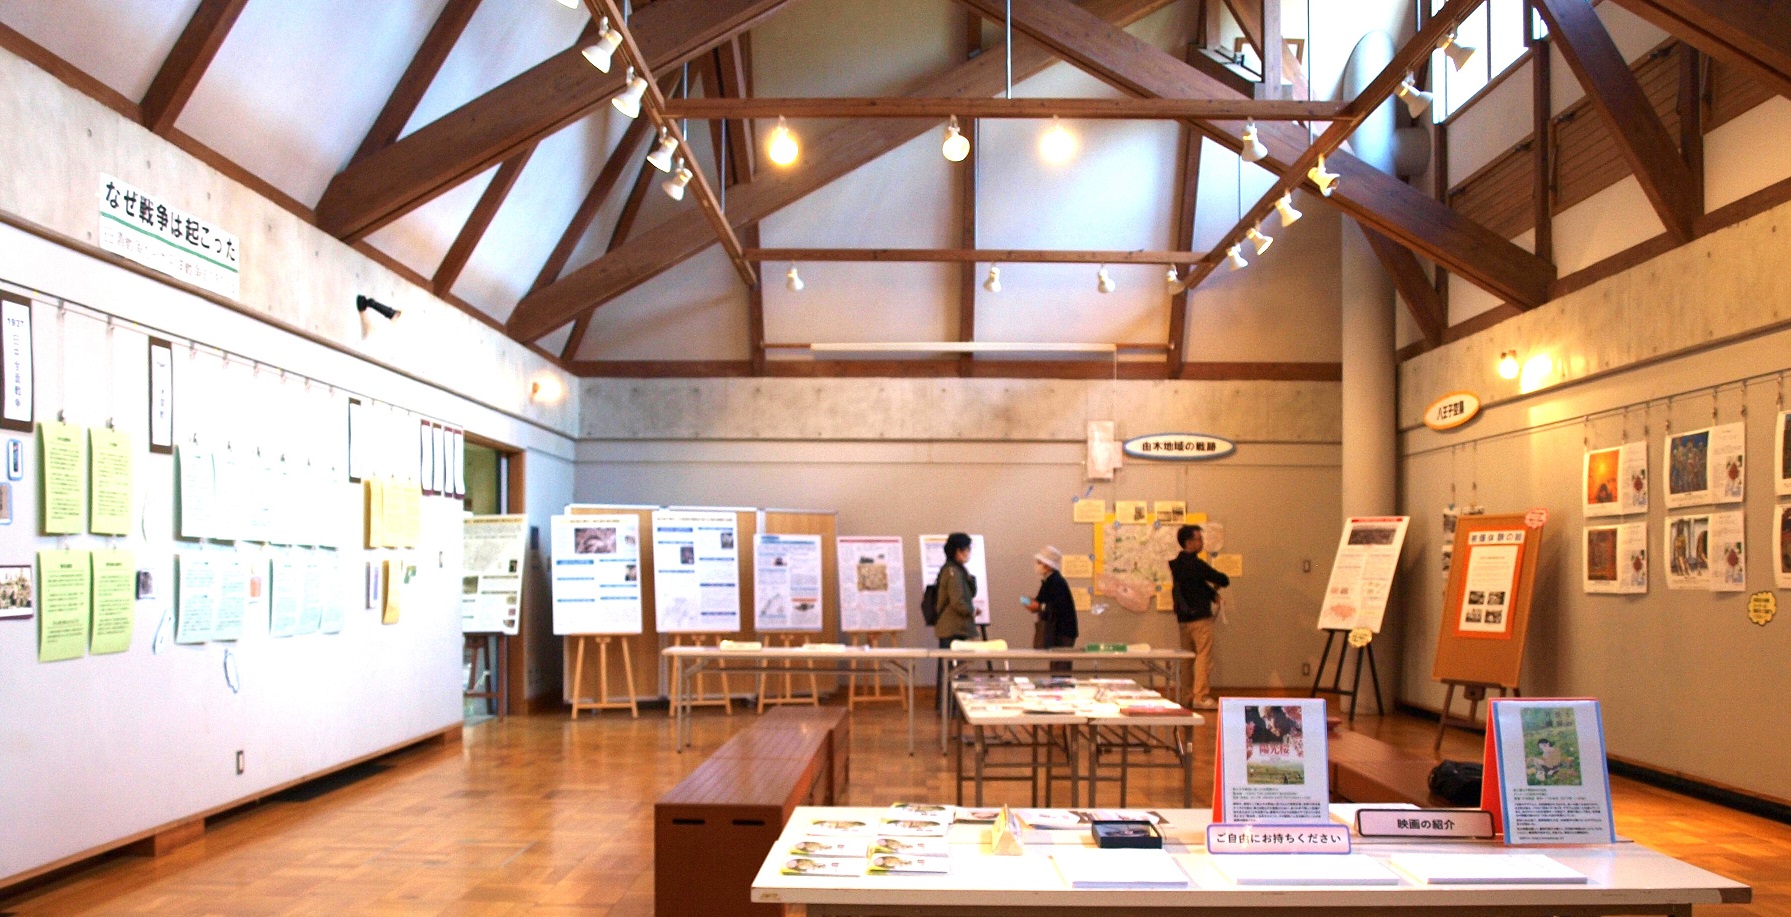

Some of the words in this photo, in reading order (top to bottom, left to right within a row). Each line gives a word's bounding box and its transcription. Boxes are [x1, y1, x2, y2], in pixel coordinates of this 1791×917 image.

[105, 181, 236, 262] なぜ戦争は起こった
[1397, 818, 1455, 831] 映画の紹介
[1216, 832, 1342, 845] ご自由にお持ちください
